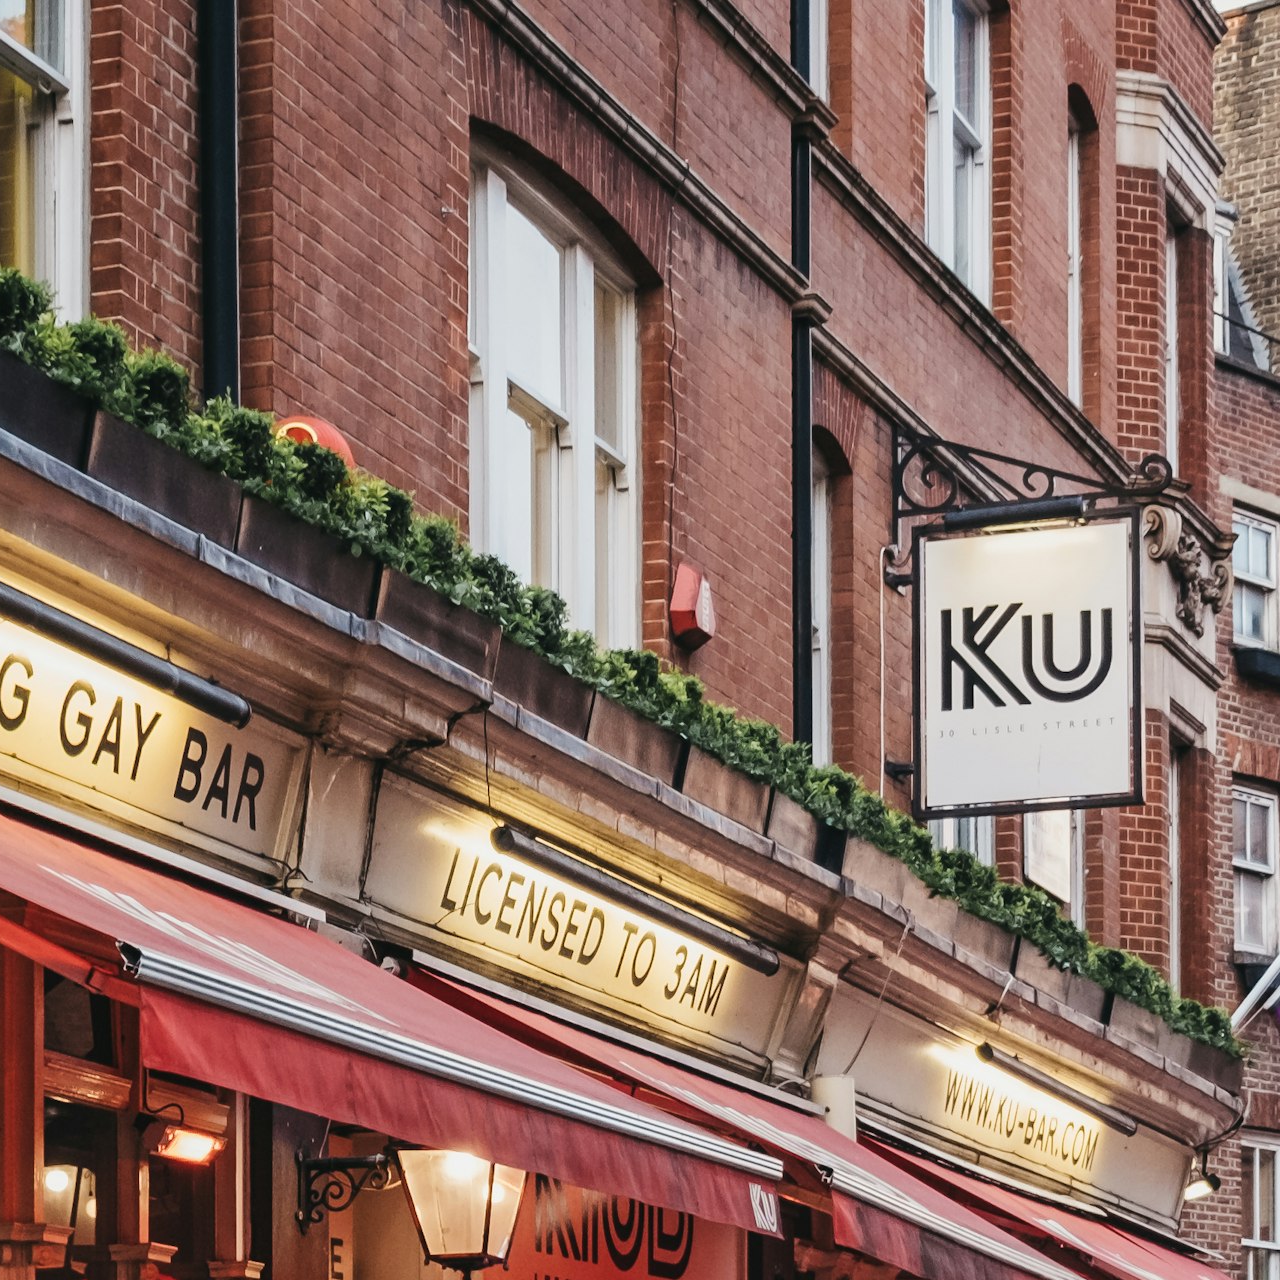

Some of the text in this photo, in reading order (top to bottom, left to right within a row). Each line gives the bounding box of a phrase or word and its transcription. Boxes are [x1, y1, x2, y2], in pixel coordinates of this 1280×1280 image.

[941, 603, 1113, 712] KU
[59, 680, 162, 782] GAY
[174, 728, 266, 831] BAR
[972, 725, 1026, 737] LISLE
[1043, 716, 1116, 731] STREET
[440, 848, 730, 1017] LICENSED TO 3AM
[944, 1068, 1100, 1172] WWW.KU-BAR.COM
[748, 1182, 777, 1233] KU
